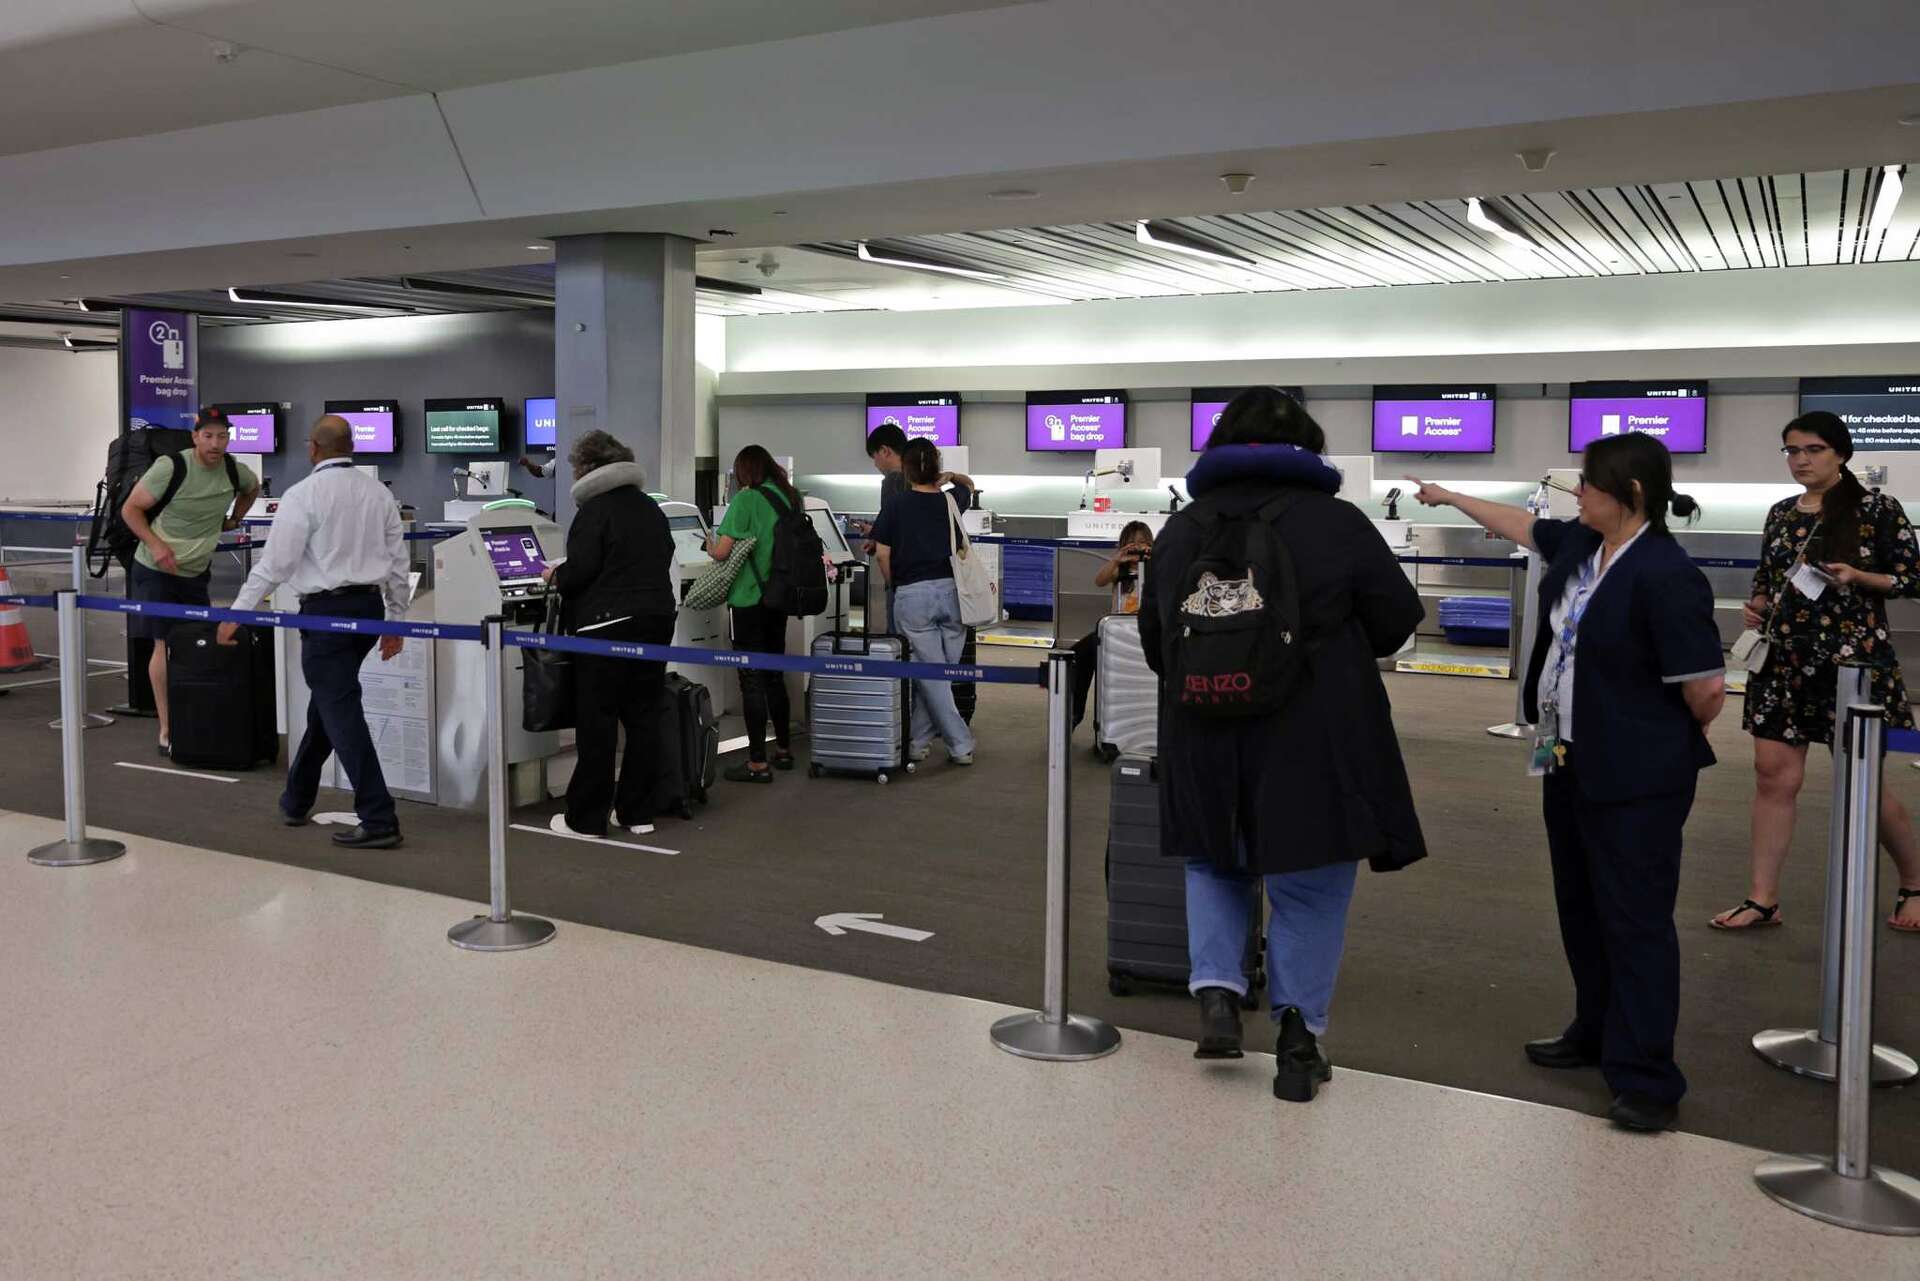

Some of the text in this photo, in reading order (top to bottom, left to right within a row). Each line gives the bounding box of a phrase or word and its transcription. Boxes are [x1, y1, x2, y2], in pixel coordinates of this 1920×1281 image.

[140, 375, 173, 384] Premier
[155, 387, 188, 397] bag drop
[907, 415, 936, 424] Premier
[1070, 414, 1100, 423] Premier
[1424, 416, 1461, 426] Premier
[1628, 415, 1669, 425] Premier
[1848, 414, 1862, 423] for
[1863, 414, 1906, 423] checked
[1907, 414, 1920, 423] ba
[535, 419, 556, 428] UNI
[1070, 432, 1104, 442] bag drop
[1085, 523, 1125, 531] UNITED
[611, 646, 637, 654] UNITED
[714, 655, 741, 663] UNITED
[825, 663, 854, 671] UNITED
[944, 669, 974, 677] UNITED
